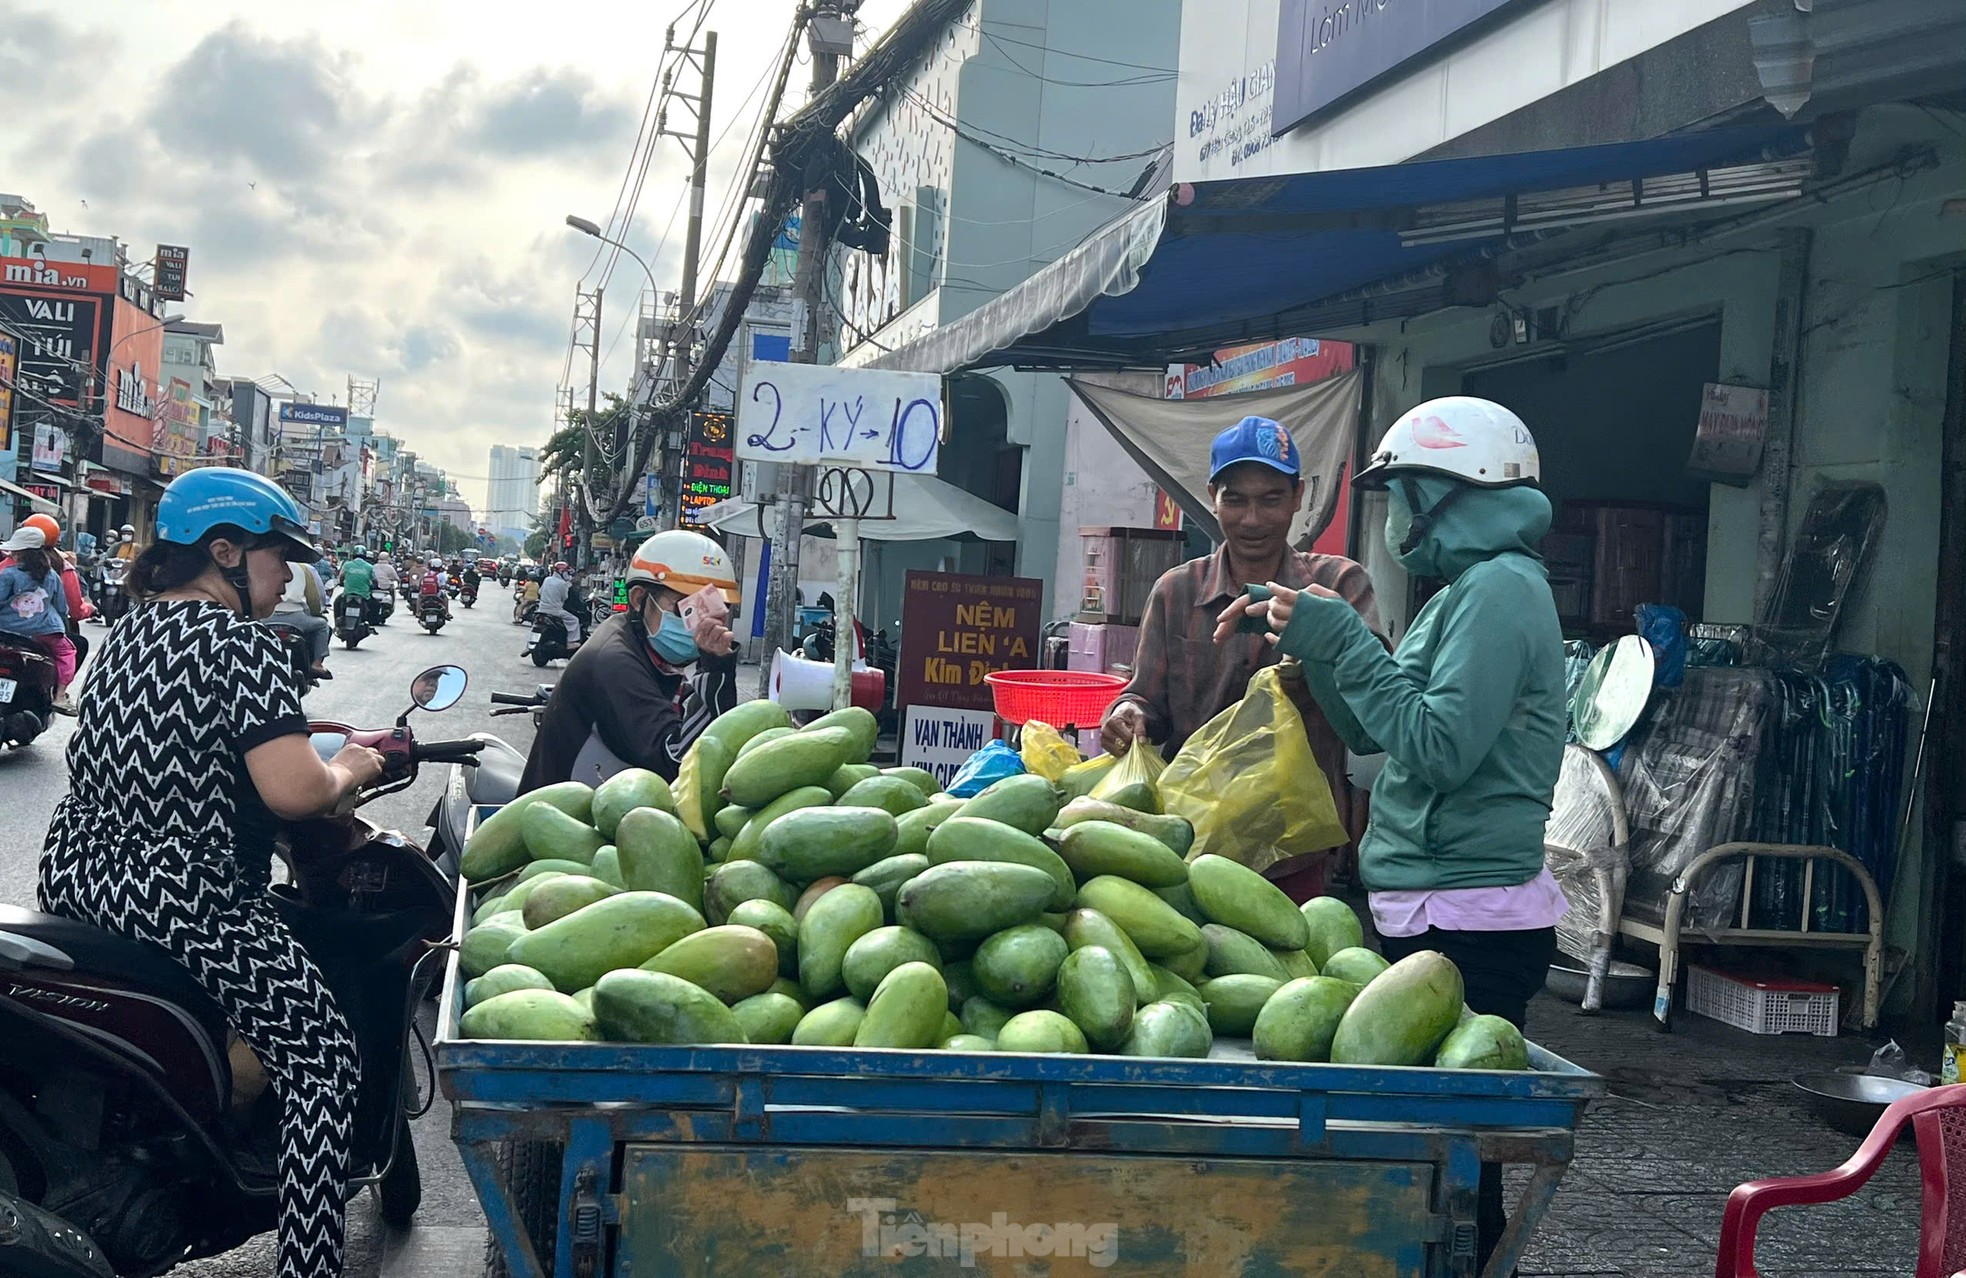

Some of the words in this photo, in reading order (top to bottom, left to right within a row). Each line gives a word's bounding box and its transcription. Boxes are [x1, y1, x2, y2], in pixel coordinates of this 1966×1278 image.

[160, 247, 185, 259] mia
[5, 261, 87, 288] mia.vn
[24, 299, 75, 322] VALI
[294, 411, 341, 422] KidsPlaza
[876, 397, 938, 470] 10
[639, 518, 653, 530] 653
[955, 600, 1015, 632] NỆM
[923, 657, 962, 685] Kim
[914, 718, 940, 753] VẠN
[943, 715, 984, 751] THÀNH
